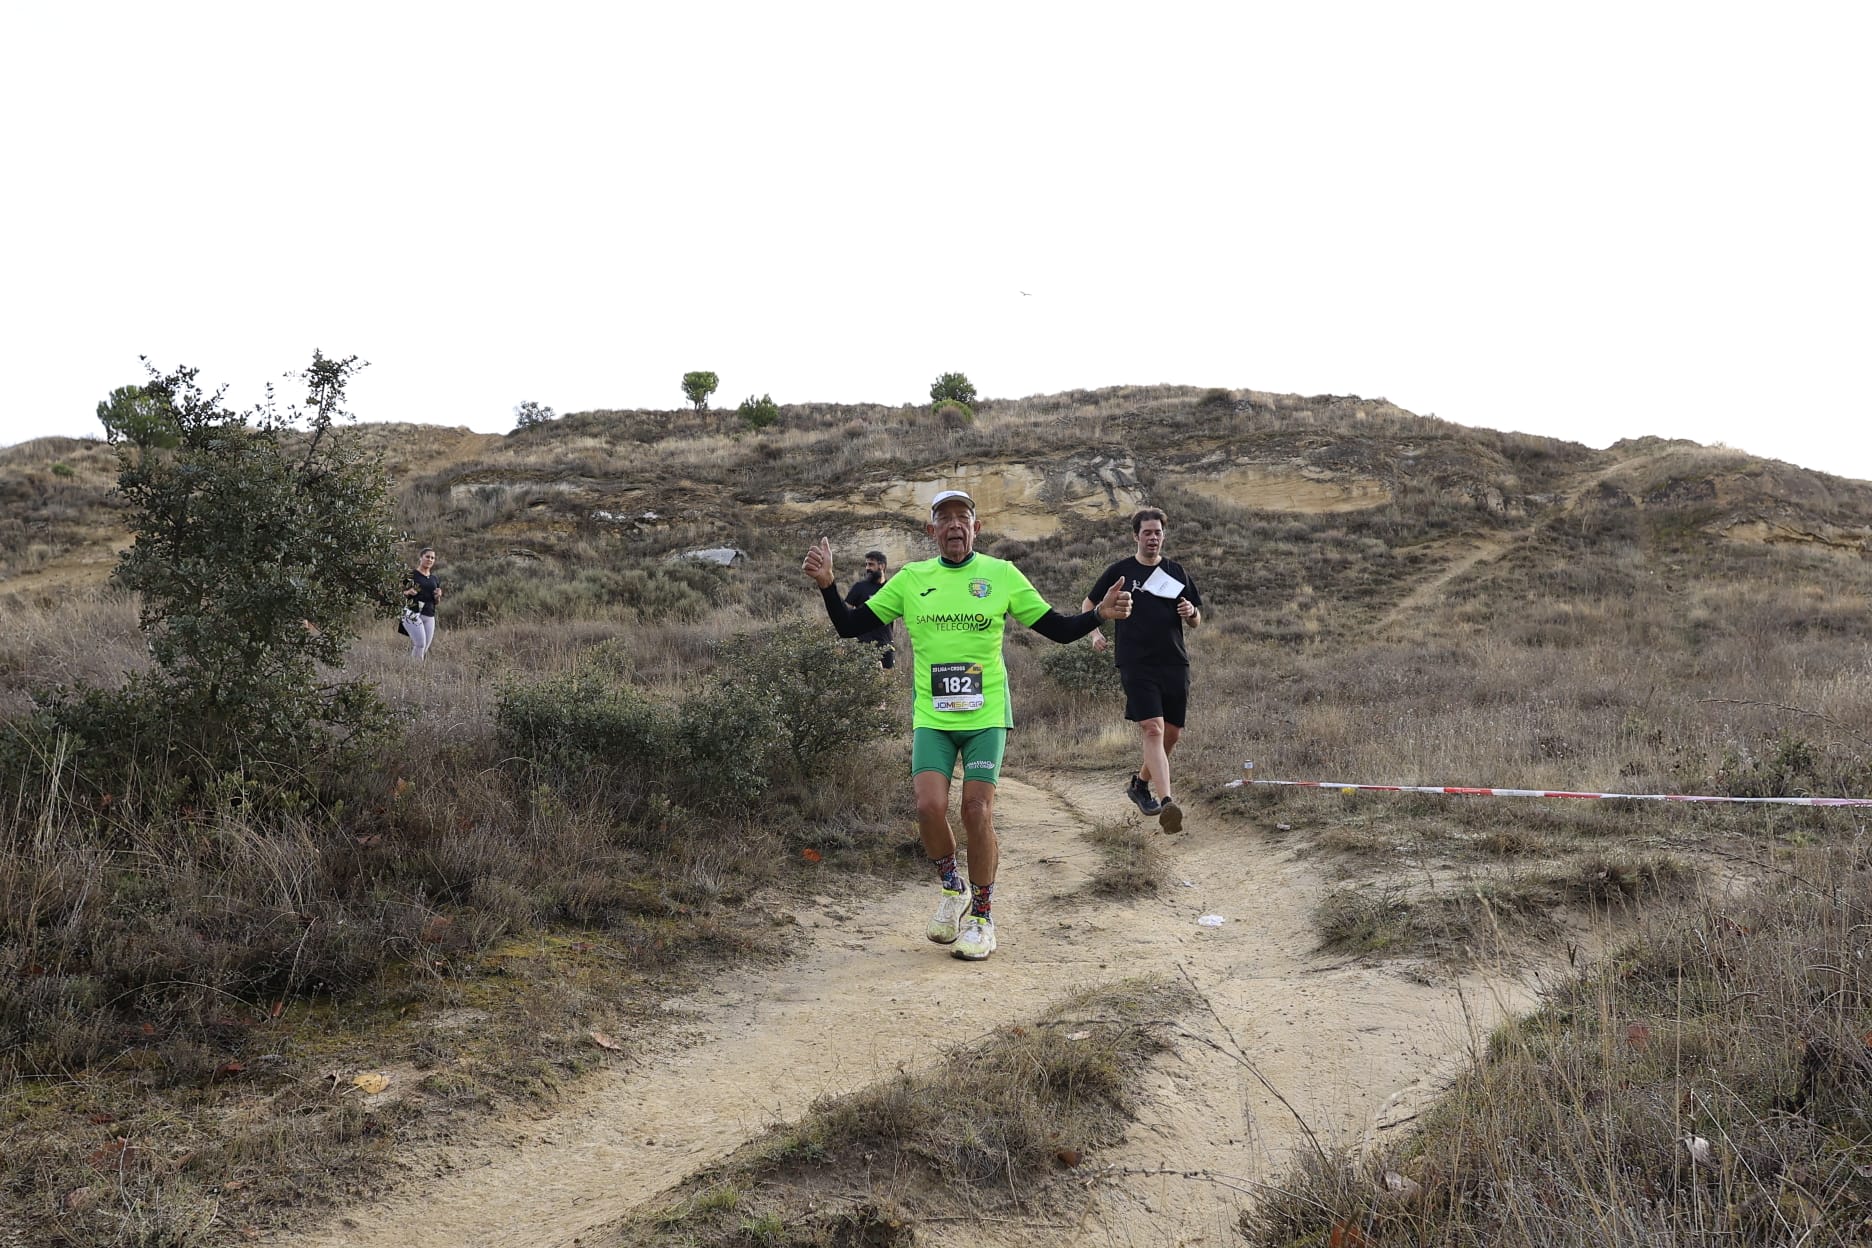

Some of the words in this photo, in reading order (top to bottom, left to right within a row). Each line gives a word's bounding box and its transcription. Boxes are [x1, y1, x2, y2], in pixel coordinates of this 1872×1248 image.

[916, 613, 985, 625] SANMAXIMO
[936, 622, 979, 631] TELECOM
[942, 676, 972, 693] 182
